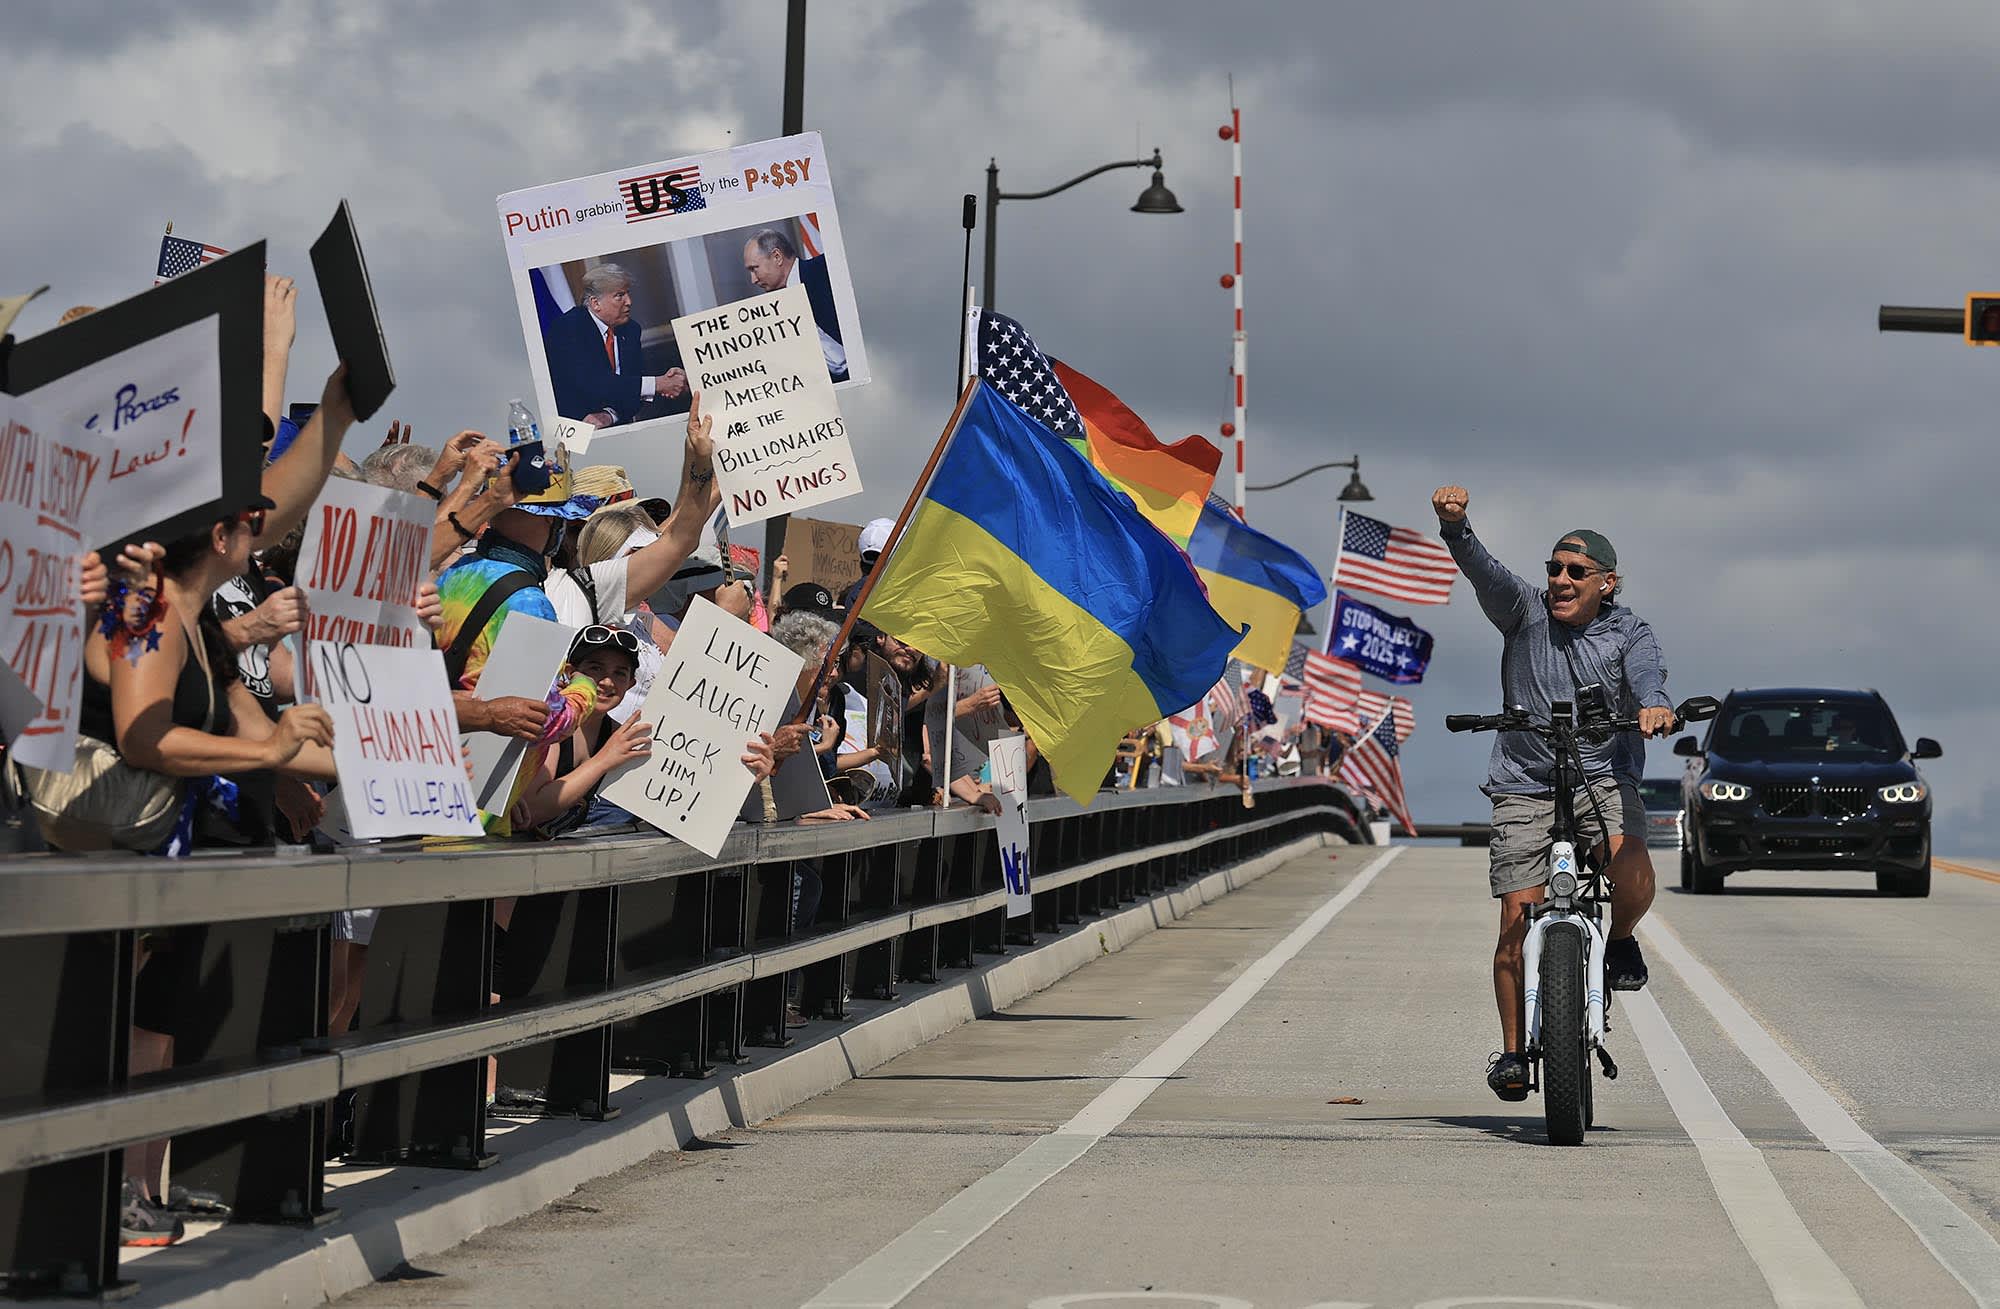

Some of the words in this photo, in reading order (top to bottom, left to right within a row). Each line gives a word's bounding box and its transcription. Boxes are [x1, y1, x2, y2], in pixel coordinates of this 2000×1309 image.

[505, 206, 571, 237] Putin
[575, 198, 626, 222] grabbin'
[630, 174, 688, 215] US
[699, 181, 717, 194] by
[718, 176, 739, 191] the
[691, 314, 730, 337] THE
[738, 300, 780, 323] ONLY
[694, 315, 801, 365] MINORITY
[701, 359, 767, 390] RUINING
[724, 374, 805, 410] AMERICA
[554, 423, 576, 438] NO
[718, 417, 844, 473] BILLIONAIRES
[727, 421, 751, 439] ARE
[757, 410, 785, 427] THE
[732, 489, 767, 516] NO
[776, 462, 847, 500] KINGS
[309, 505, 357, 592] NO
[1342, 608, 1372, 631] STOP
[1372, 617, 1423, 648] PROJECT
[1361, 634, 1394, 665] 2025
[321, 641, 371, 704] NO
[704, 627, 771, 689] LIVE.
[668, 661, 765, 733] LAUGH
[352, 706, 456, 766] HUMAN
[653, 715, 721, 774] LOCK
[660, 757, 696, 786] HIM
[363, 778, 385, 815] IS
[394, 777, 477, 823] ILLEGAL
[645, 778, 701, 822] UP!
